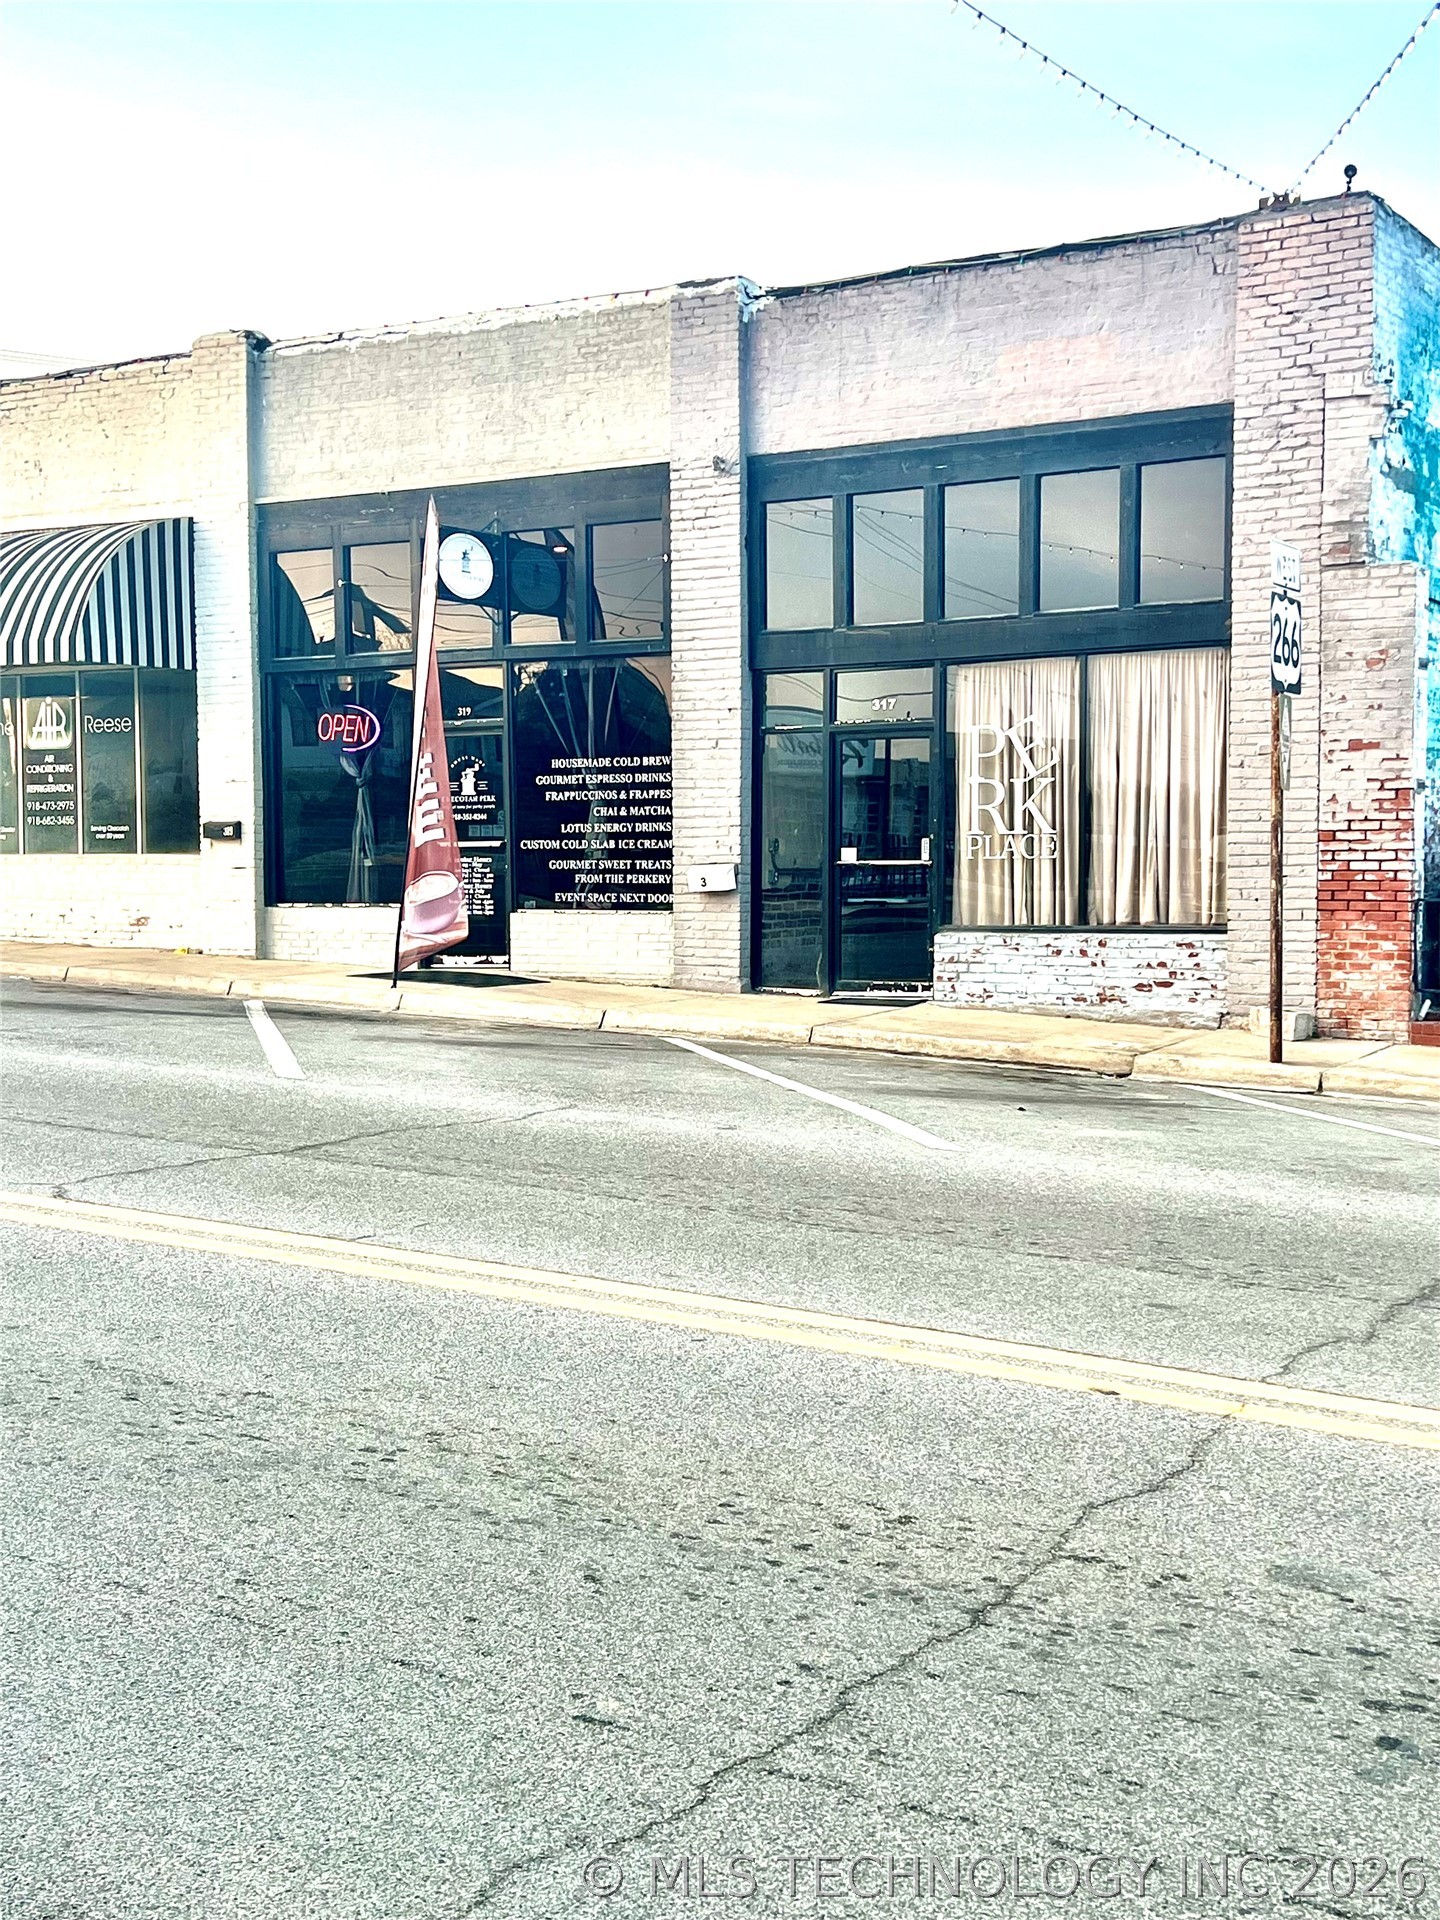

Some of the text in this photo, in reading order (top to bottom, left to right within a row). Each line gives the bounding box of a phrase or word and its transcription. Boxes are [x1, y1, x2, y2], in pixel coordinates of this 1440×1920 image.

[1272, 612, 1300, 669] 266
[871, 698, 897, 711] 317
[457, 706, 471, 716] 319
[84, 715, 132, 733] Reese
[317, 713, 370, 743] OPEN
[44, 754, 55, 763] AIR
[552, 756, 671, 768] HOUSEMADE COLD BREW
[26, 763, 74, 774] CONDITIONING
[536, 773, 671, 785] GOURMET ESPRESSO DRINKS
[26, 784, 74, 793] REFRIGERATION
[546, 790, 671, 800] FRAPPUCCINOS & FRAPPES
[26, 801, 75, 811] 918-473-2975
[594, 806, 671, 816] CHAI & MATCHA
[26, 815, 75, 826] 918-682-3455
[561, 823, 671, 833] LOTUS ENERGY DRINKS
[521, 839, 673, 849] CUSTOM COLD SLAB ICE CREAM
[966, 835, 1058, 860] PLACE
[549, 860, 671, 869] GOURMET SWEET TREATS
[575, 874, 671, 883] FROM THE PERKERY
[700, 877, 707, 887] 3
[555, 893, 586, 902] EVENT
[588, 893, 617, 902] SPACE
[620, 894, 646, 902] NEXT
